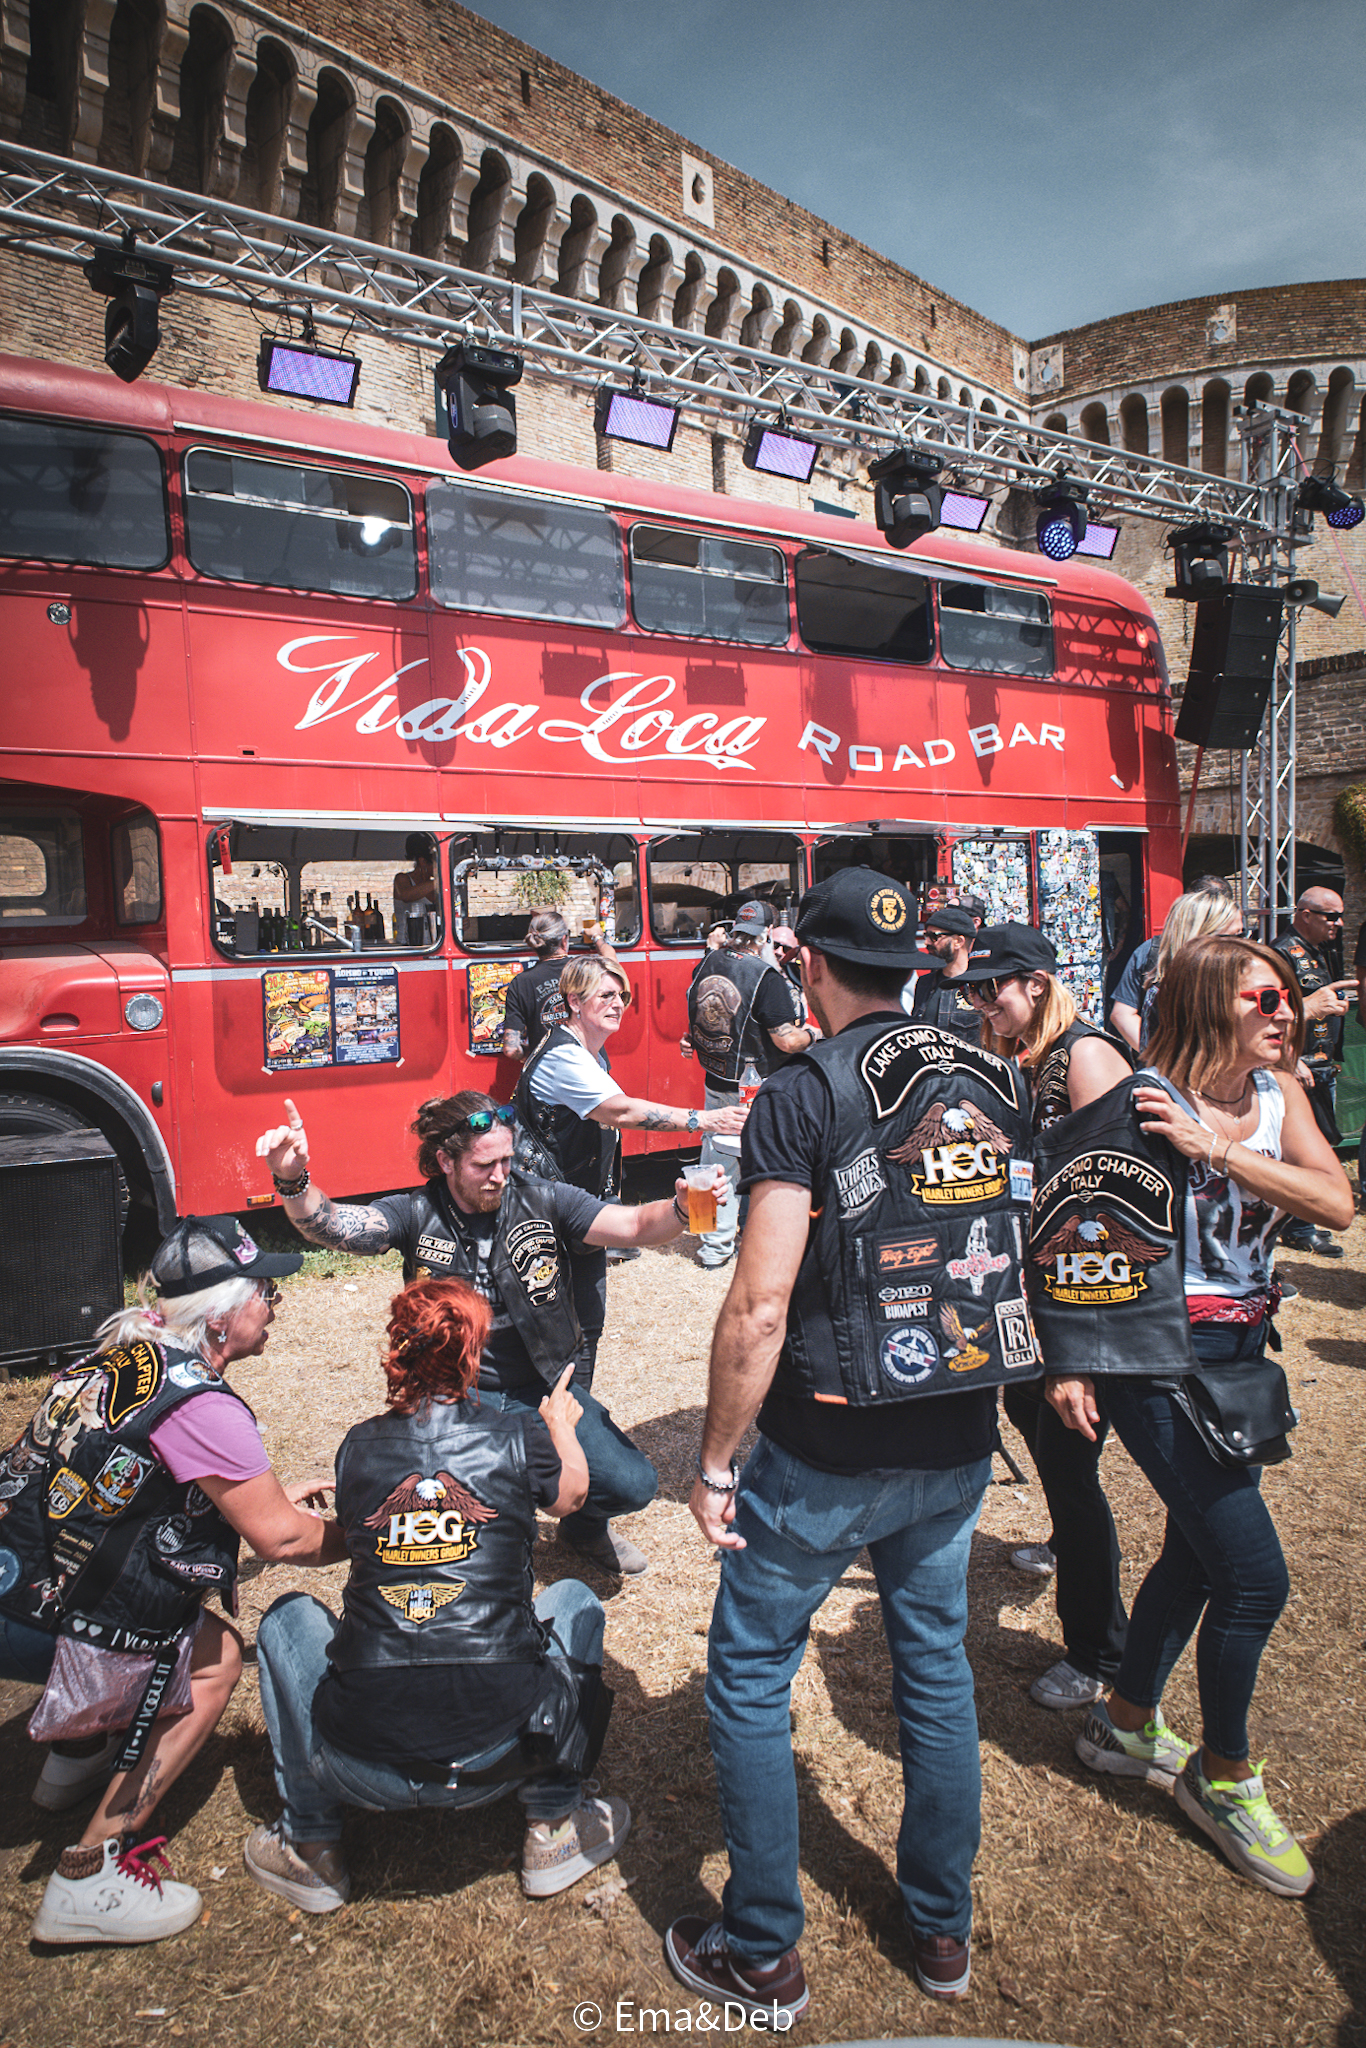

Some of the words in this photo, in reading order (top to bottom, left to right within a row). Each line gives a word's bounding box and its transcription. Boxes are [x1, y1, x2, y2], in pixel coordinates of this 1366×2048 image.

[276, 635, 540, 748] Vida
[537, 671, 768, 771] Loca
[968, 722, 1066, 758] BAR
[536, 978, 561, 995] ESP
[868, 1042, 902, 1078] LAKE
[896, 1029, 938, 1050] COMO
[939, 1032, 1003, 1072] CHAPTER
[918, 1045, 955, 1062] ITALY
[834, 1153, 880, 1191] WHEELS
[920, 1141, 998, 1185] HOG
[924, 1187, 954, 1200] HARLEY
[954, 1183, 985, 1200] OWNERS
[1034, 1180, 1060, 1212] LAKE
[1061, 1157, 1093, 1182] COMO
[1097, 1156, 1165, 1197] CHAPTER
[1070, 1174, 1104, 1192] ITALY
[522, 1223, 546, 1233] CAPTAIN
[433, 1238, 455, 1252] YEAR
[1055, 1251, 1132, 1285] HOG
[1054, 1286, 1080, 1300] HARLEY
[1079, 1289, 1110, 1301] OWNERS
[1110, 1285, 1134, 1299] GROUP
[885, 1301, 928, 1320] BUDAPEST
[1007, 1352, 1031, 1364] ROLL
[131, 1343, 153, 1396] CHAPTER
[386, 1510, 465, 1547] HOG
[384, 1550, 410, 1562] HARLEY
[409, 1549, 440, 1562] OWNERS
[440, 1545, 464, 1559] GROUP
